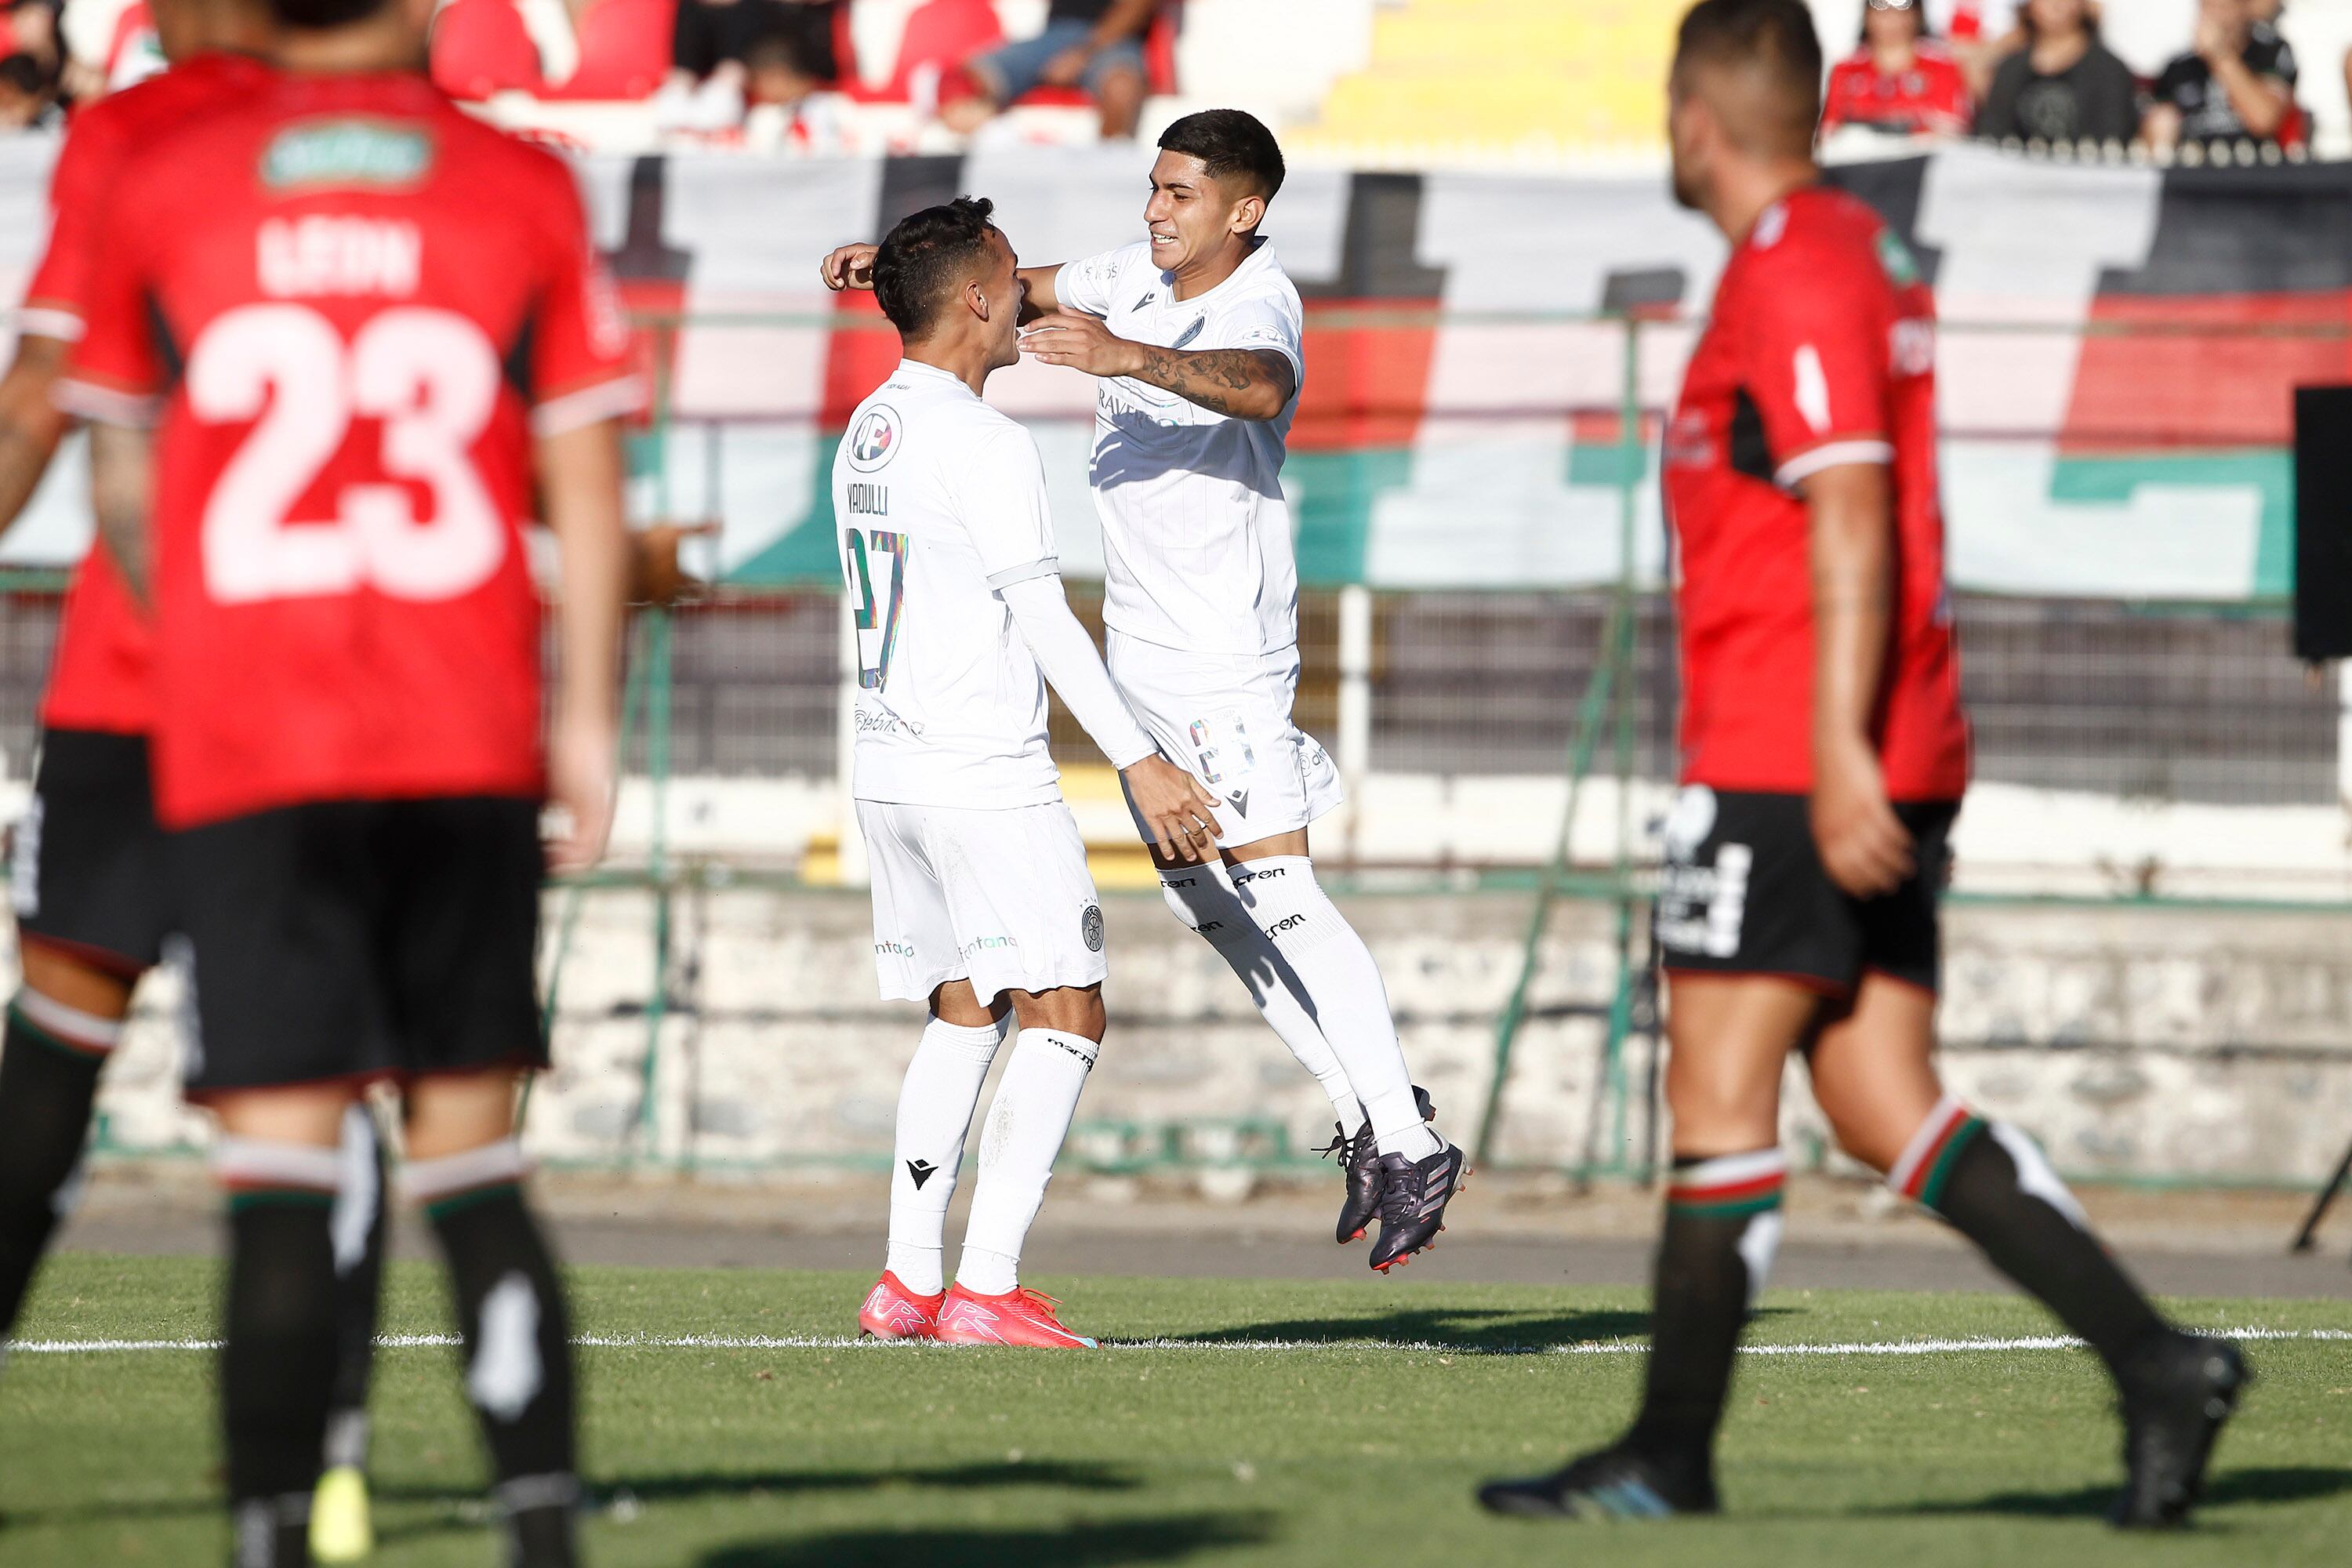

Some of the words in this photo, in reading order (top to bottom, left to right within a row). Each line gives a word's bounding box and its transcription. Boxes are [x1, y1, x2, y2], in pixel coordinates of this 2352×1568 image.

[187, 302, 507, 605] 23
[846, 528, 909, 694] 27
[1232, 868, 1285, 888] cron
[1265, 913, 1306, 942] cron
